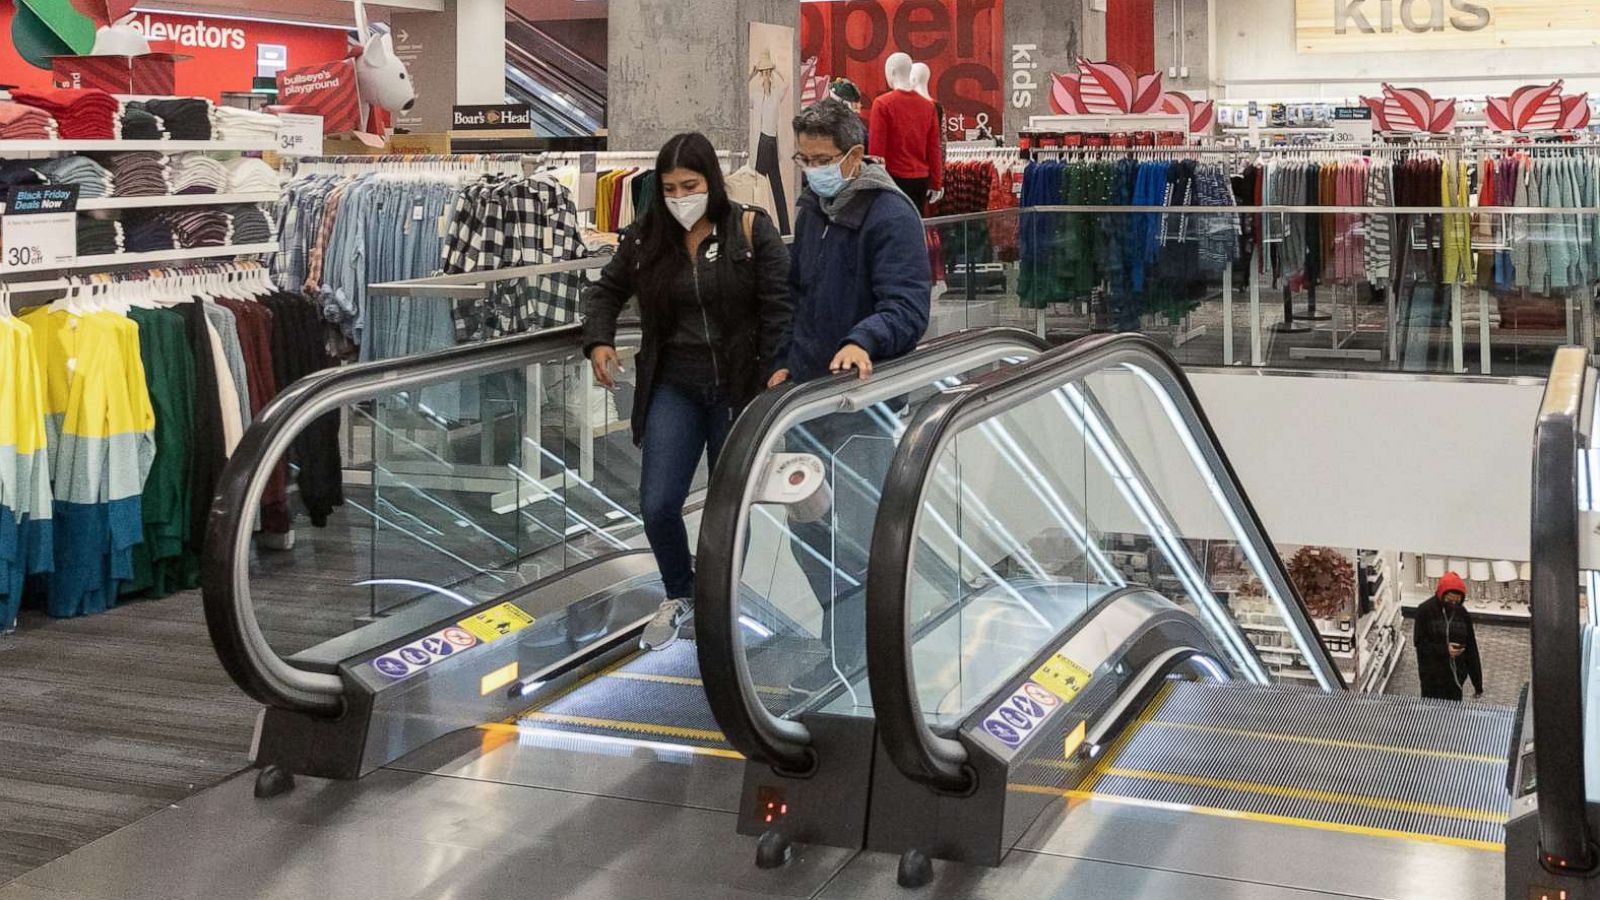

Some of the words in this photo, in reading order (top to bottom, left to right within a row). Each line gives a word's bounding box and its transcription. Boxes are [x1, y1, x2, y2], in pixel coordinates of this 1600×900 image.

[284, 70, 331, 86] bullseye's
[1012, 44, 1038, 109] kids
[285, 78, 339, 97] playground
[454, 111, 486, 125] Boar's
[501, 110, 530, 124] Head
[17, 191, 42, 200] Black
[44, 190, 71, 199] Friday
[15, 201, 40, 210] Deals
[41, 200, 63, 209] Now
